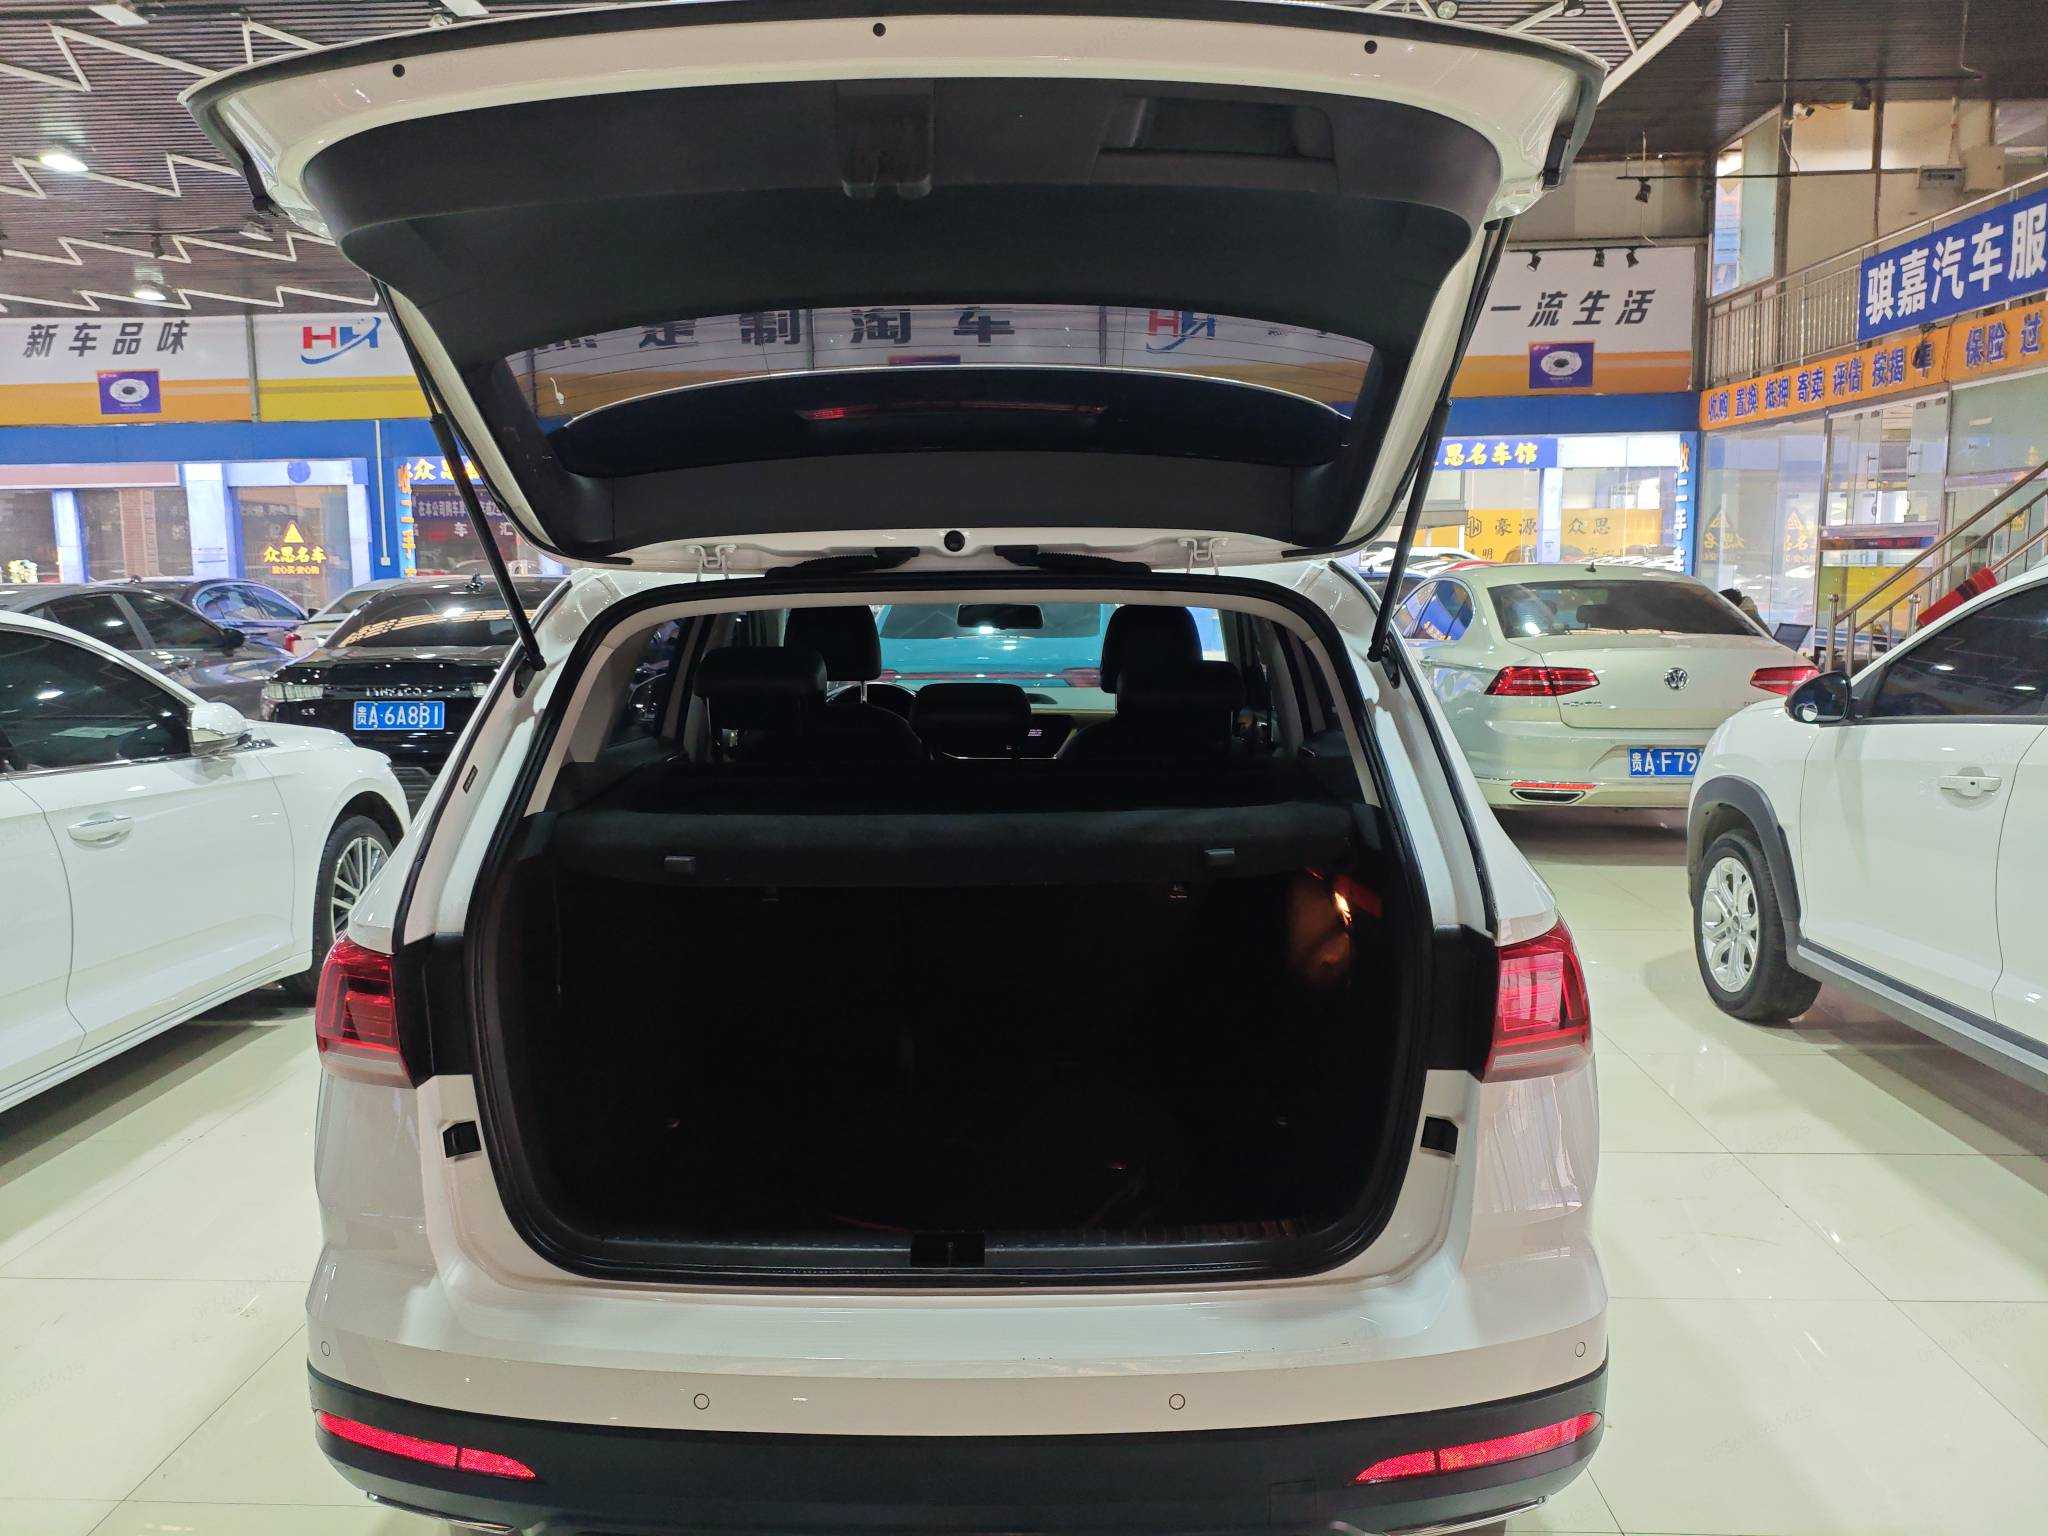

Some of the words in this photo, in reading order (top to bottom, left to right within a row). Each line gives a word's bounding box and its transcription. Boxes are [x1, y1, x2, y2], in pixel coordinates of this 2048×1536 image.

[1866, 203, 2047, 325] 骐嘉汽车服
[1491, 289, 1656, 327] 一流生活
[22, 319, 190, 358] 新车品味
[1965, 320, 2008, 368] 保险
[1797, 366, 1824, 403] 寄卖
[1434, 441, 1538, 466] 思名车馆
